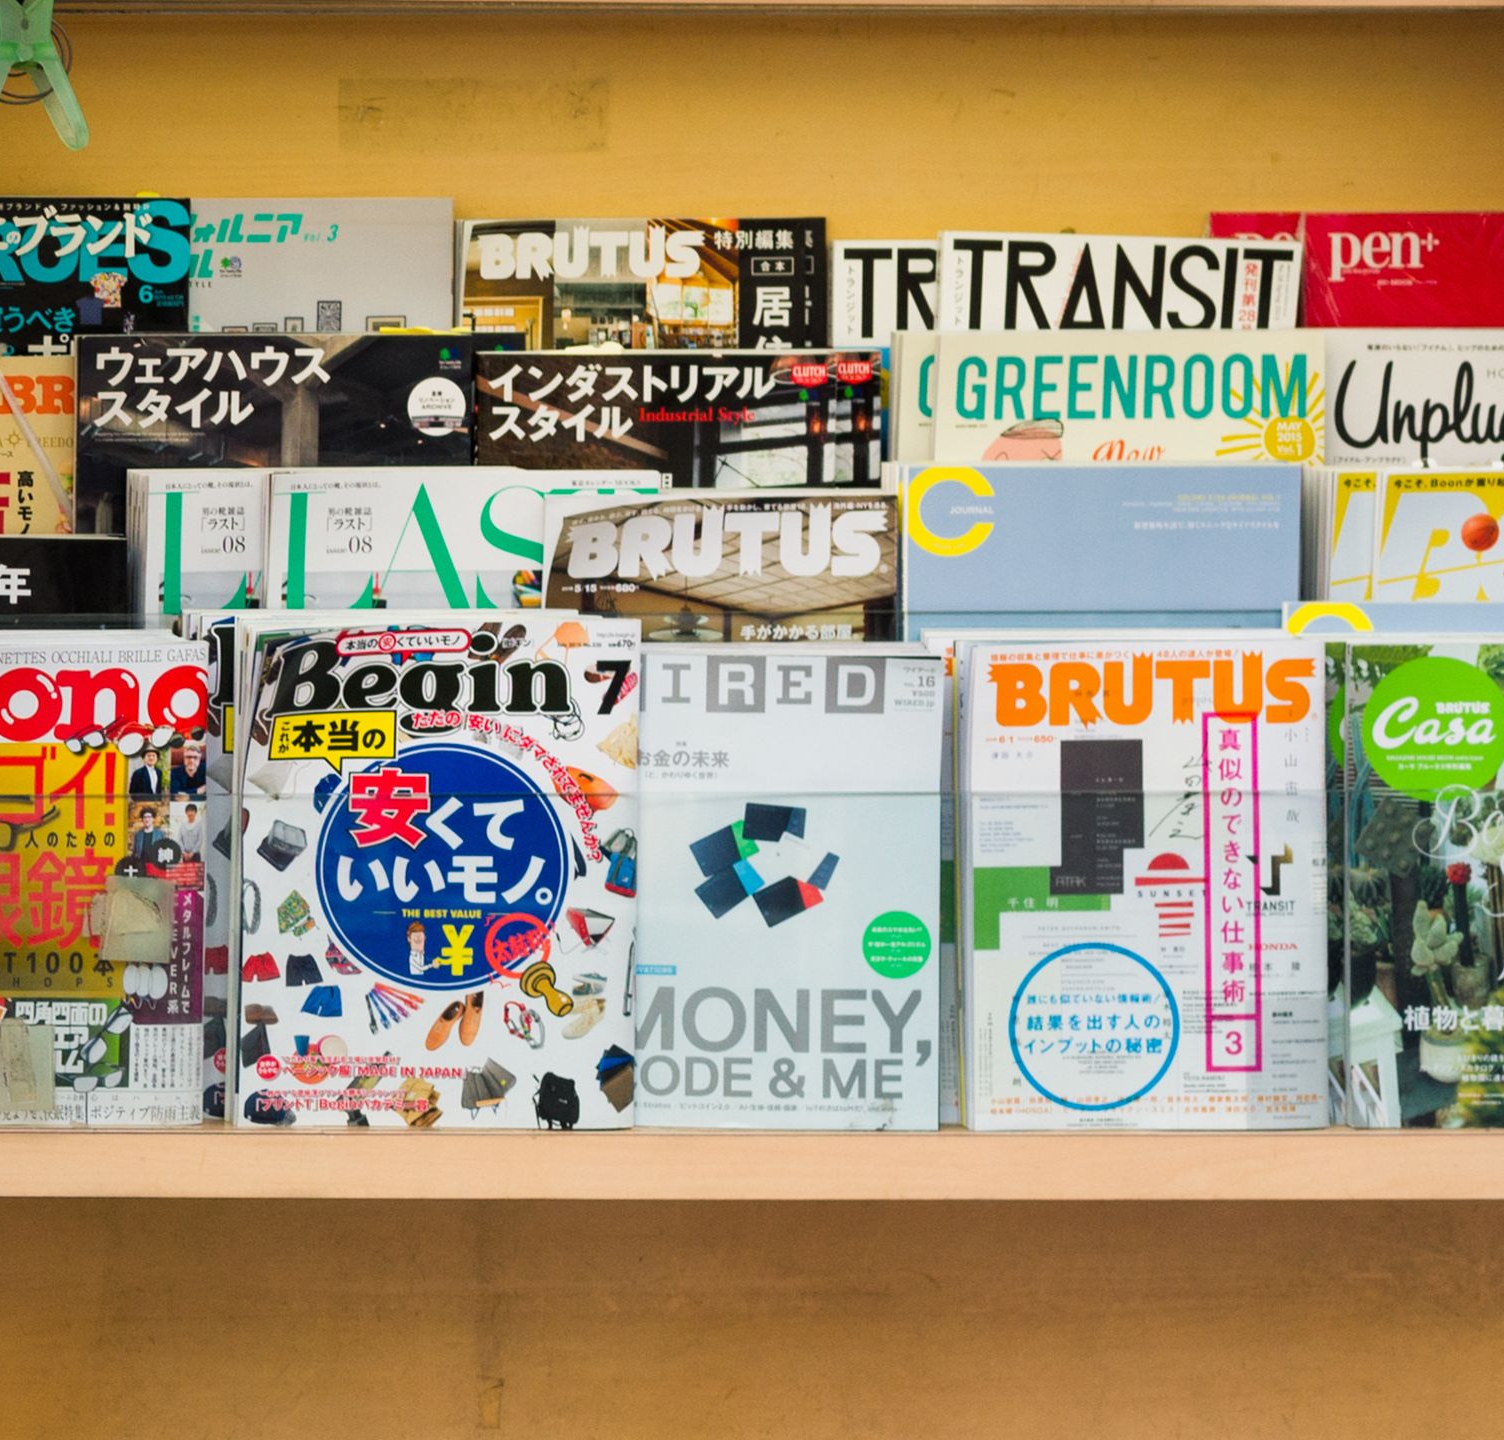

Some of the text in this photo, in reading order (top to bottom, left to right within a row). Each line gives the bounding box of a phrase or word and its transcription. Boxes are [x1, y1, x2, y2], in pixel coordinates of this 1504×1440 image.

[479, 225, 705, 282] BRUTUS
[953, 239, 1294, 331] TRANSIT
[95, 346, 331, 386] ウェアハウス
[488, 364, 776, 404] インダストリアル
[955, 353, 1308, 422] GREENROOM
[94, 391, 255, 428] スタイル
[639, 407, 713, 423] Industrial
[566, 497, 889, 581] BRUTUS
[51, 651, 112, 664] OCCHIALI
[118, 649, 163, 663] BRILLE
[167, 647, 206, 662] GAFAS
[266, 631, 632, 734] Begin 7
[986, 651, 1317, 730] BRUTUS
[1372, 697, 1496, 750] Casa
[337, 854, 555, 907] いいモノ。
[1217, 727, 1246, 1005] 真似のできない仕事術
[402, 909, 482, 919] THE BEST VALUE
[1026, 1013, 1161, 1032] 結果を出す人の
[635, 1057, 903, 1100] ODE & ME
